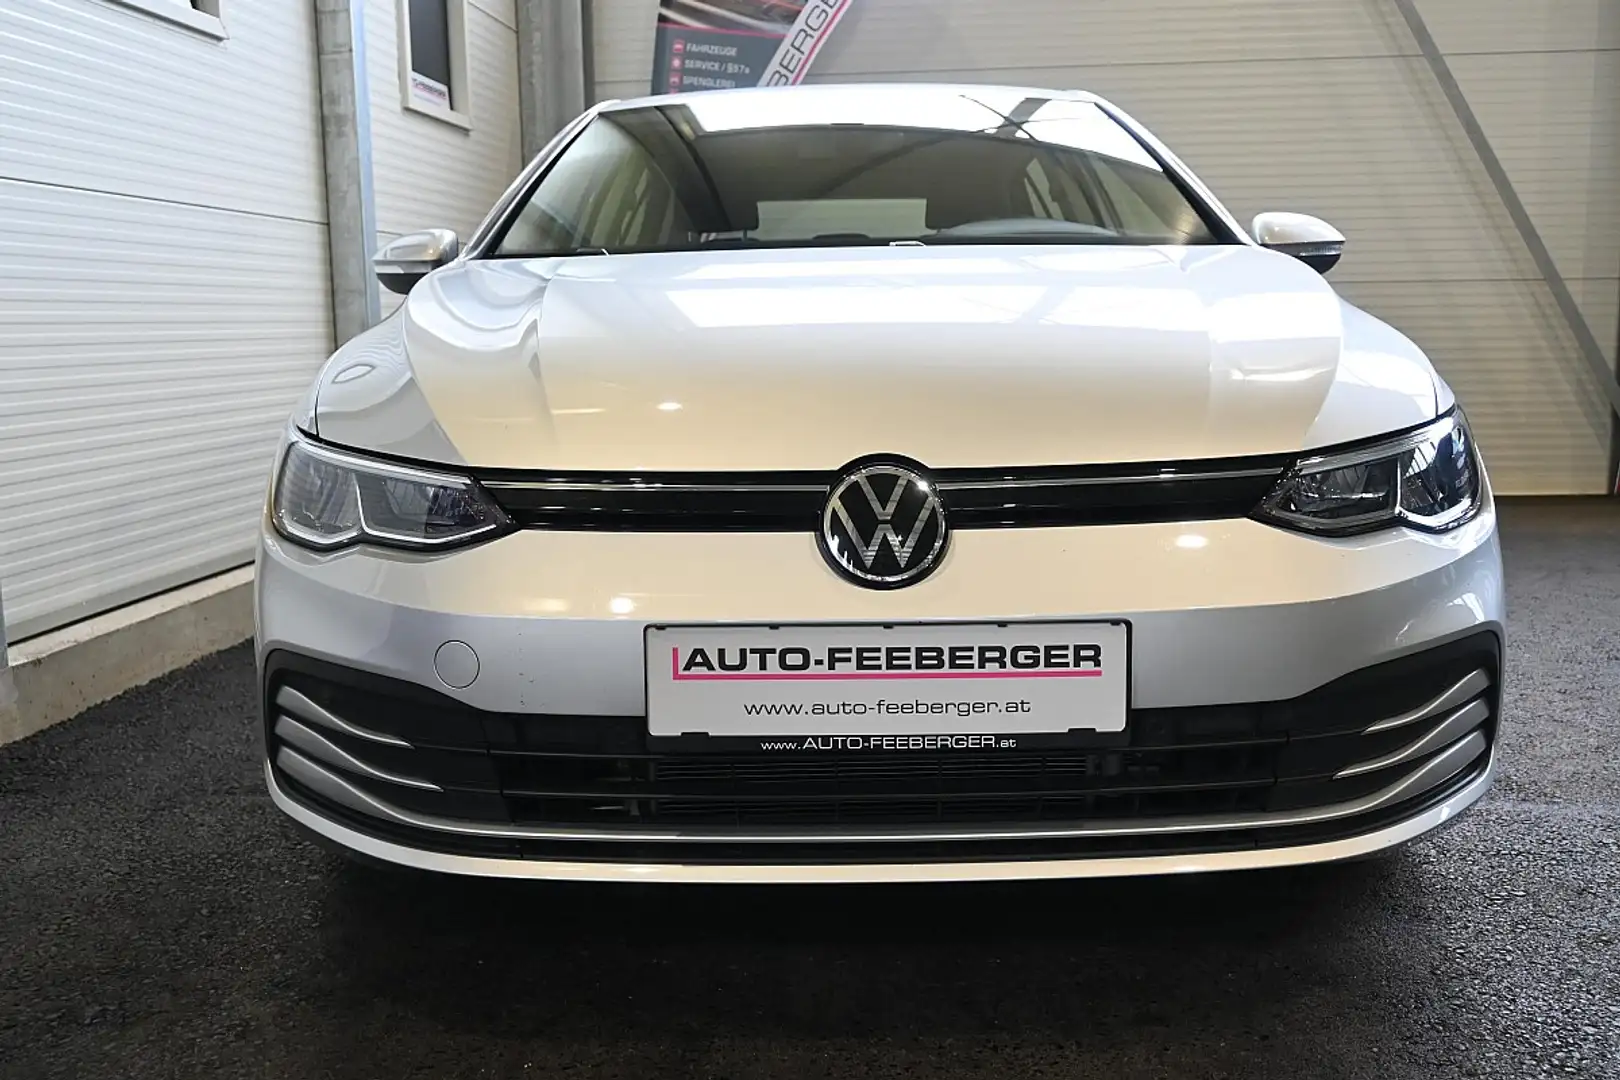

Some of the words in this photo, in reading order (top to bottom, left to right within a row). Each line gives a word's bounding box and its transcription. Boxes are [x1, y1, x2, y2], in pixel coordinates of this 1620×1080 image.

[686, 43, 738, 56] FAHRZEUGE
[684, 59, 721, 71] SERVICE
[683, 644, 1101, 672] AUTO-FEEBERGER
[744, 699, 1031, 717] www.auto-feeberger.at
[760, 735, 1017, 751] www.AUTO-FEEBERGER.at
